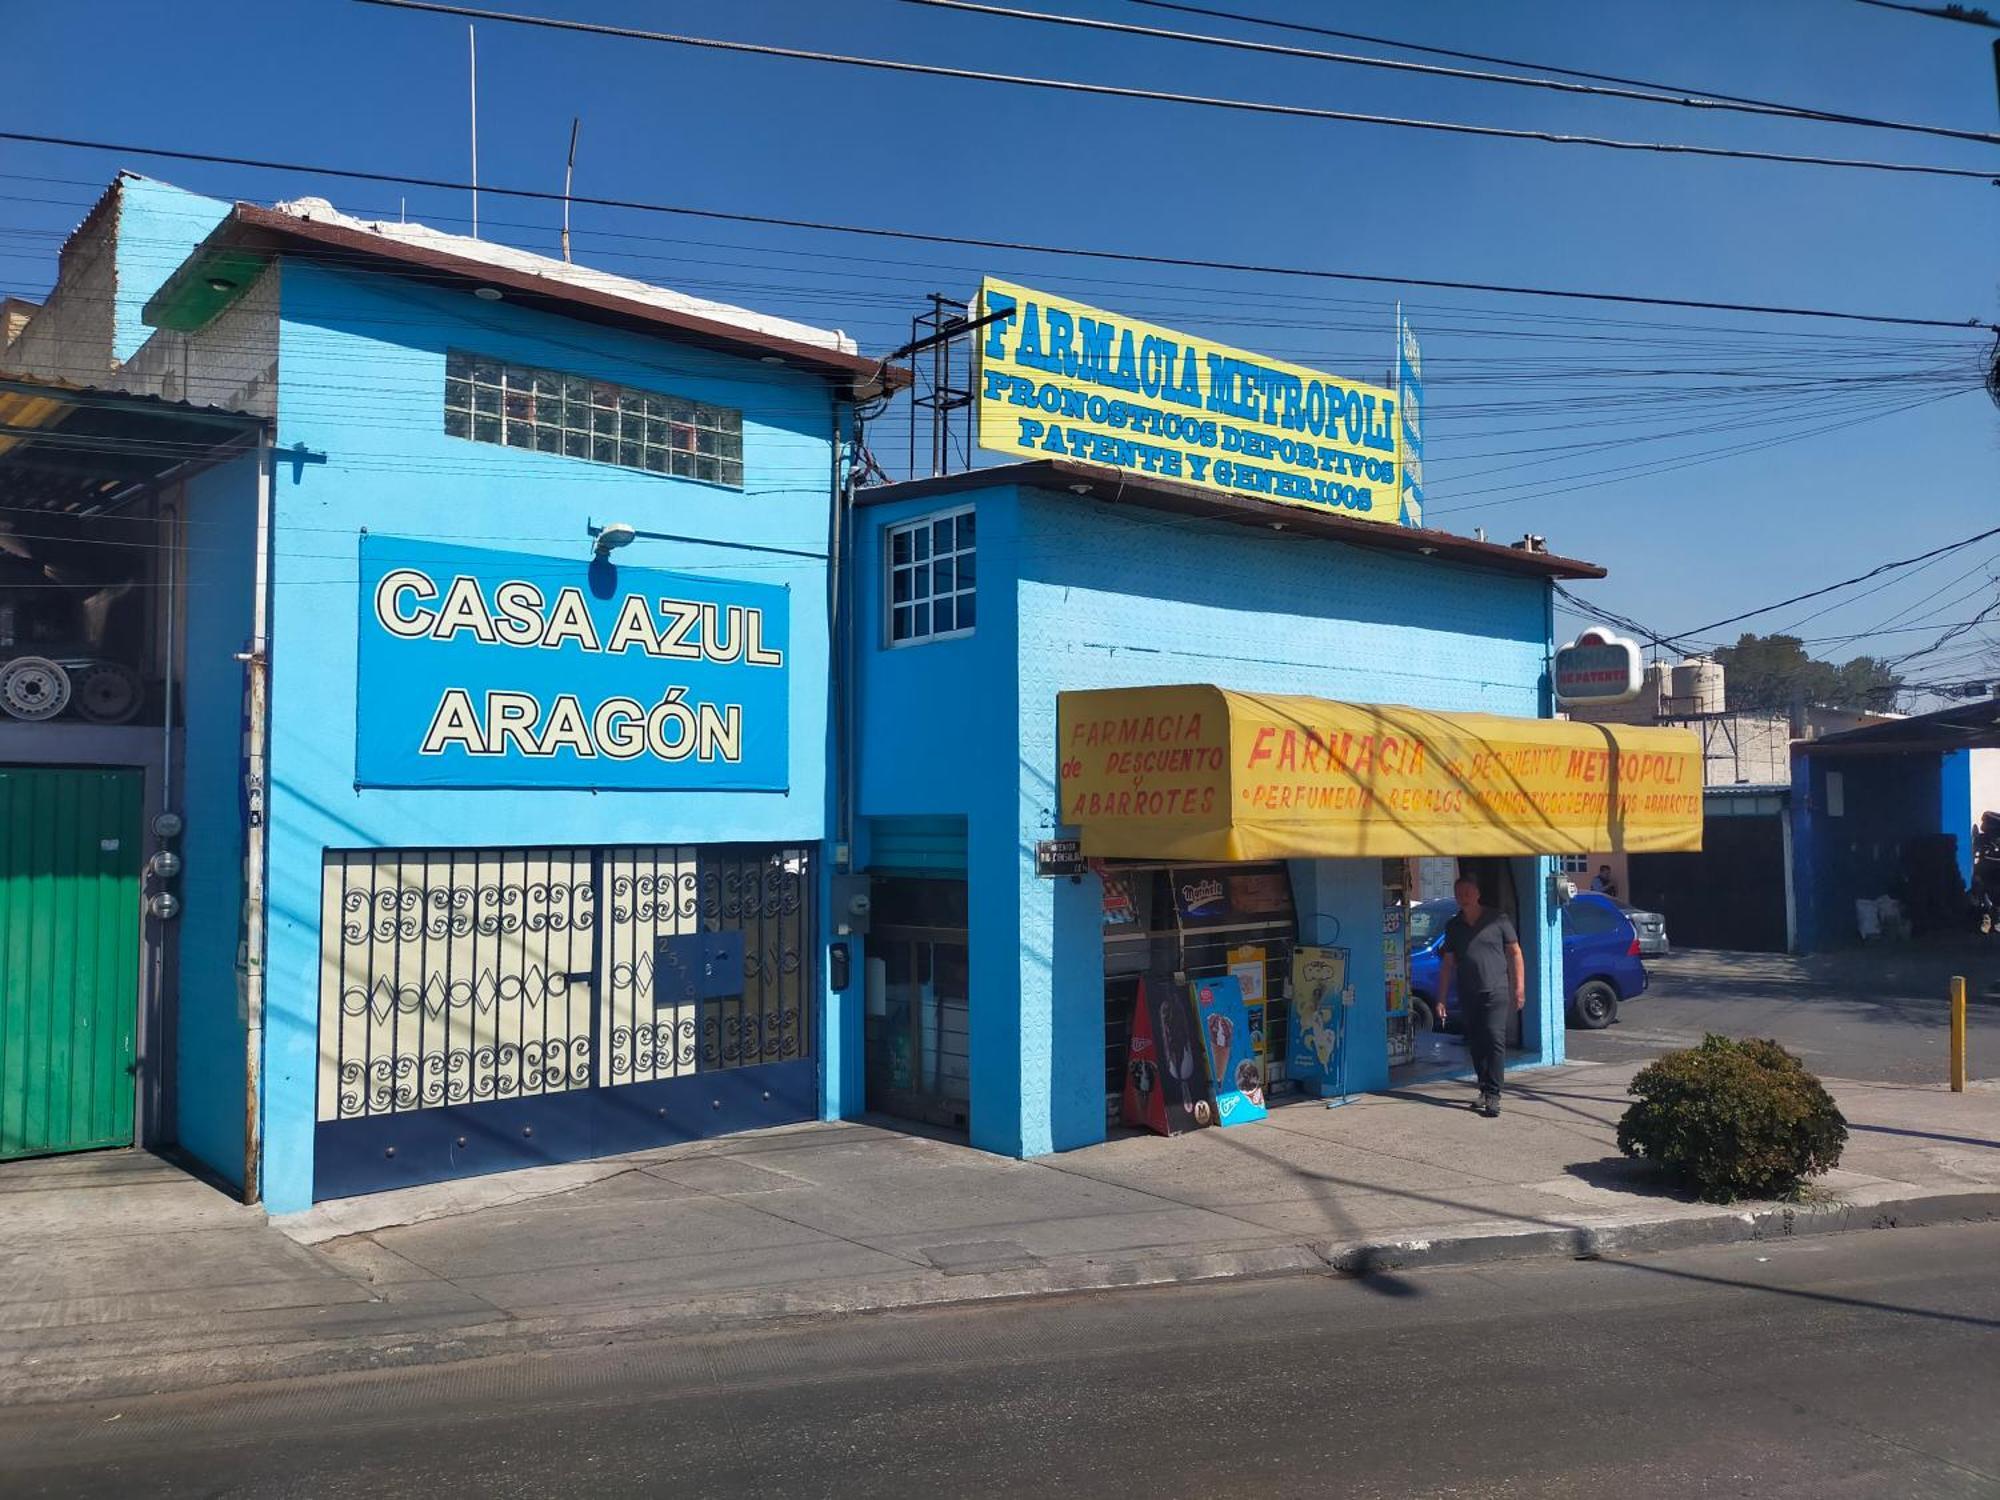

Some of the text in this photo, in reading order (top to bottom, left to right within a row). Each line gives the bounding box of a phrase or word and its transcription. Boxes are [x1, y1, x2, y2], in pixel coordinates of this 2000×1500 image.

[985, 291, 1200, 406] FARMACIA
[1207, 353, 1394, 452] METROPOLI
[983, 369, 1217, 448] PRONOSTICOS
[1220, 426, 1395, 484] DEPORTIVOS
[1018, 418, 1182, 478] PATENTE
[1185, 453, 1211, 482] Y
[1213, 461, 1372, 512] GENERICOS
[375, 568, 784, 668] CASA AZUL
[419, 686, 742, 763] ARAGÓN
[1061, 747, 1223, 779] de DESCUENTO
[1070, 713, 1201, 747] FARMACIA
[1247, 726, 1424, 777] FARMACIA
[1565, 749, 1684, 784] METROPOLI
[1072, 786, 1215, 816] ABARROTES
